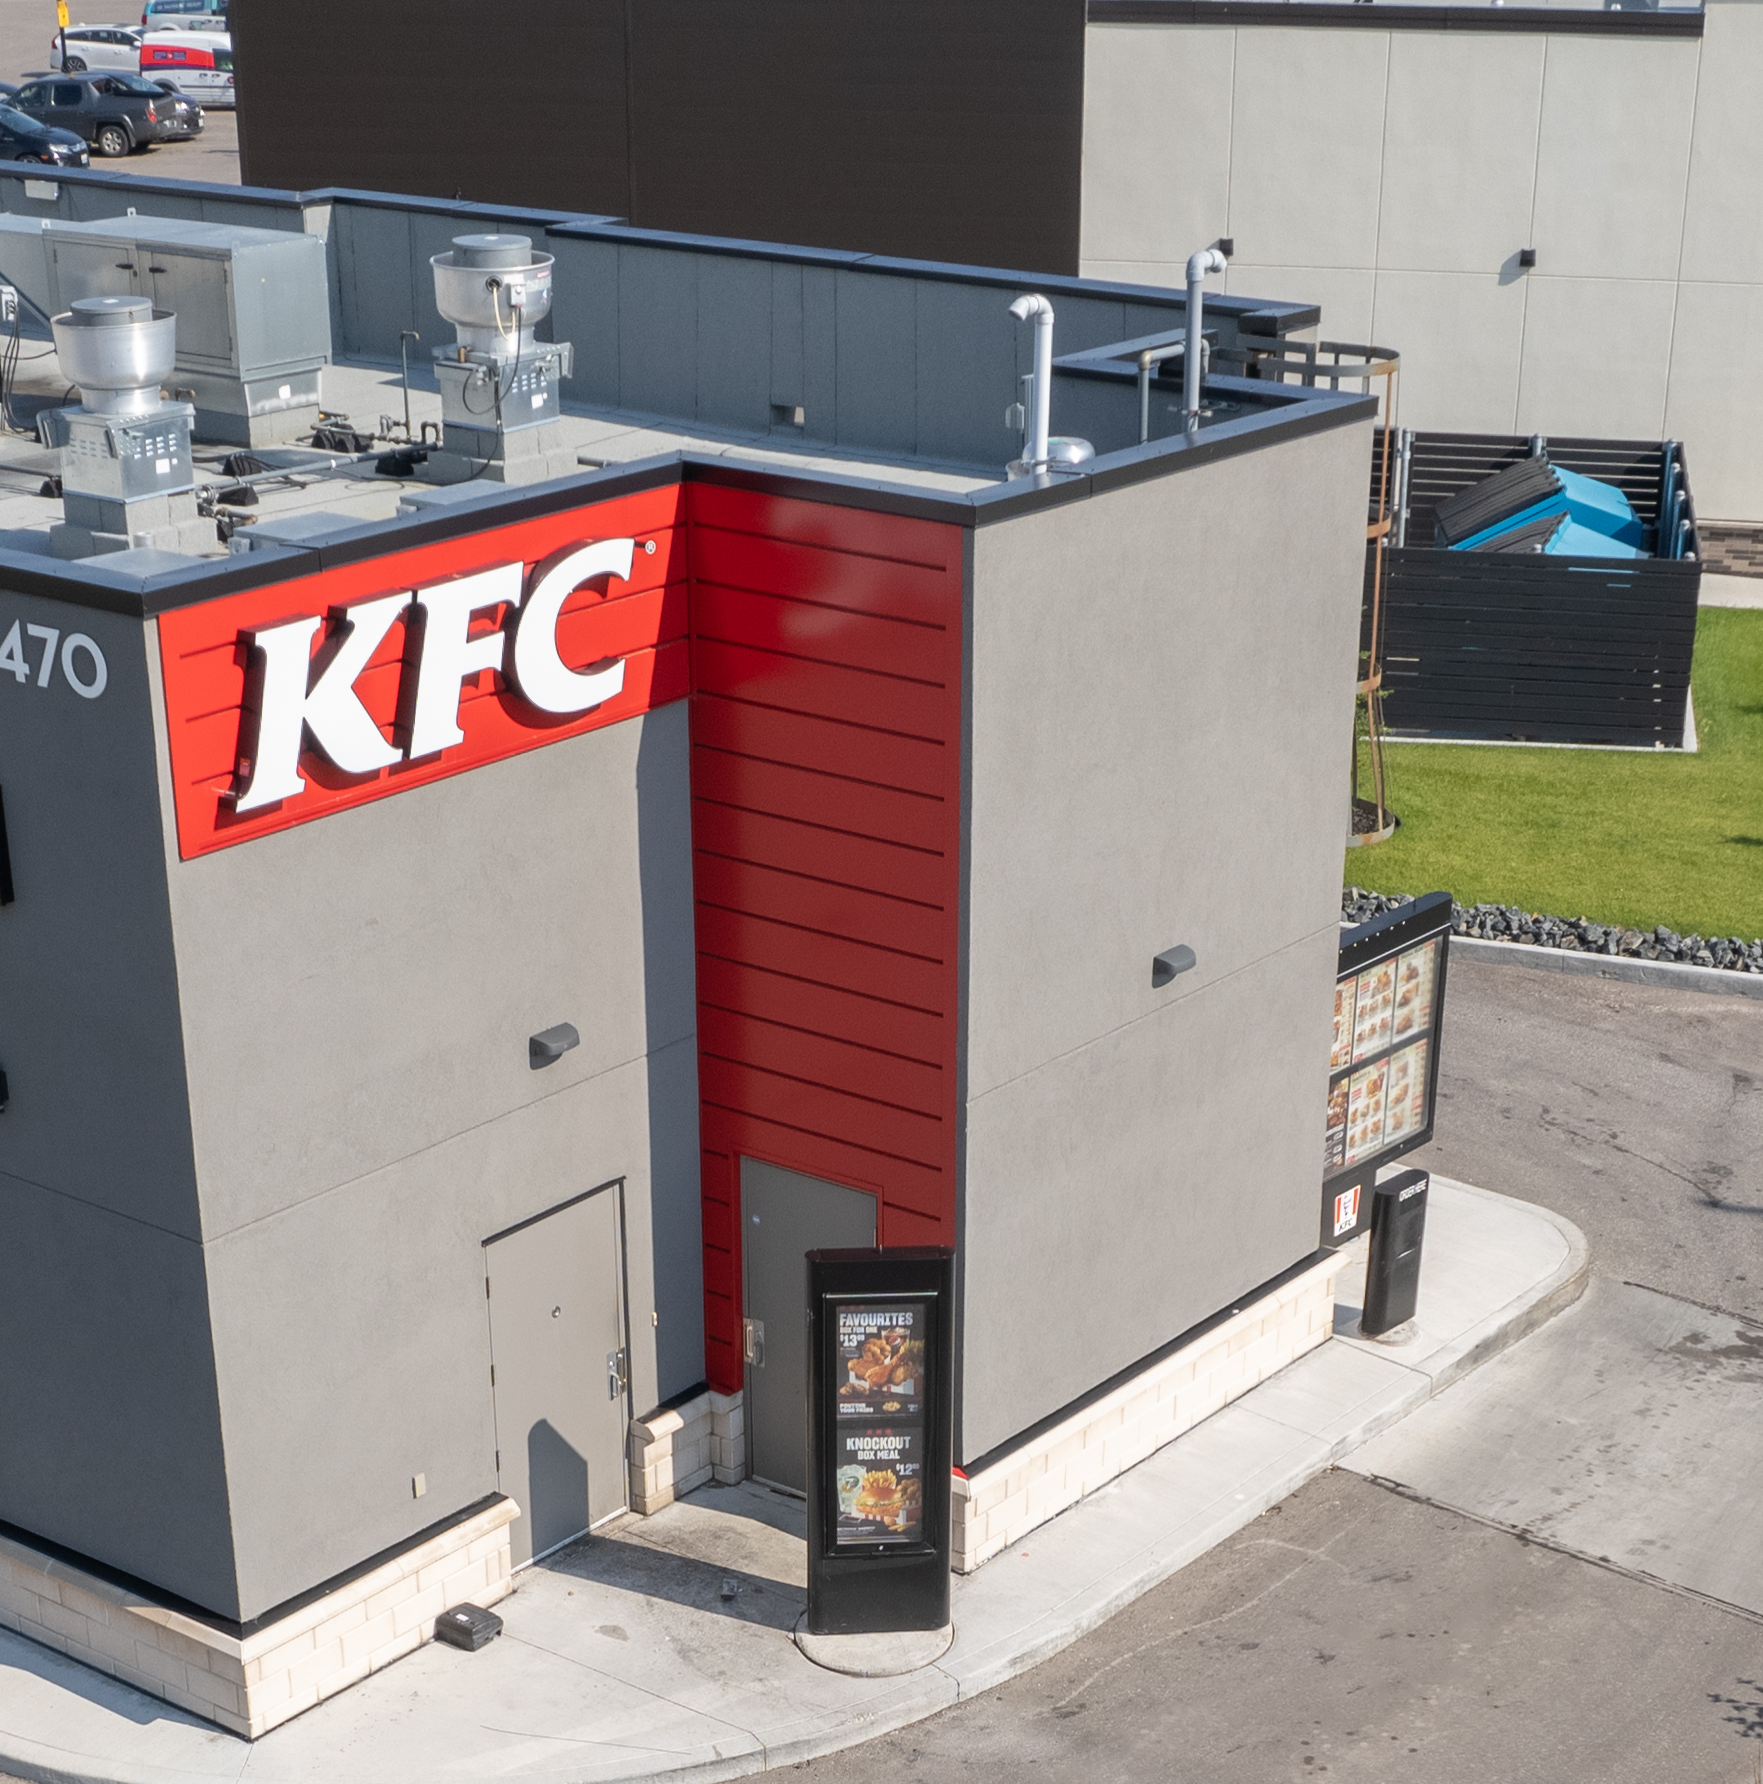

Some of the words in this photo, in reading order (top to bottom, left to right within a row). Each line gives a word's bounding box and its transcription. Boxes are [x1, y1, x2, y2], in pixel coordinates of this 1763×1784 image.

[236, 538, 635, 814] KFC
[839, 1312, 914, 1327] FAVOURITES
[846, 1436, 912, 1451] KNOCKOUT
[877, 1449, 901, 1460] MEAL
